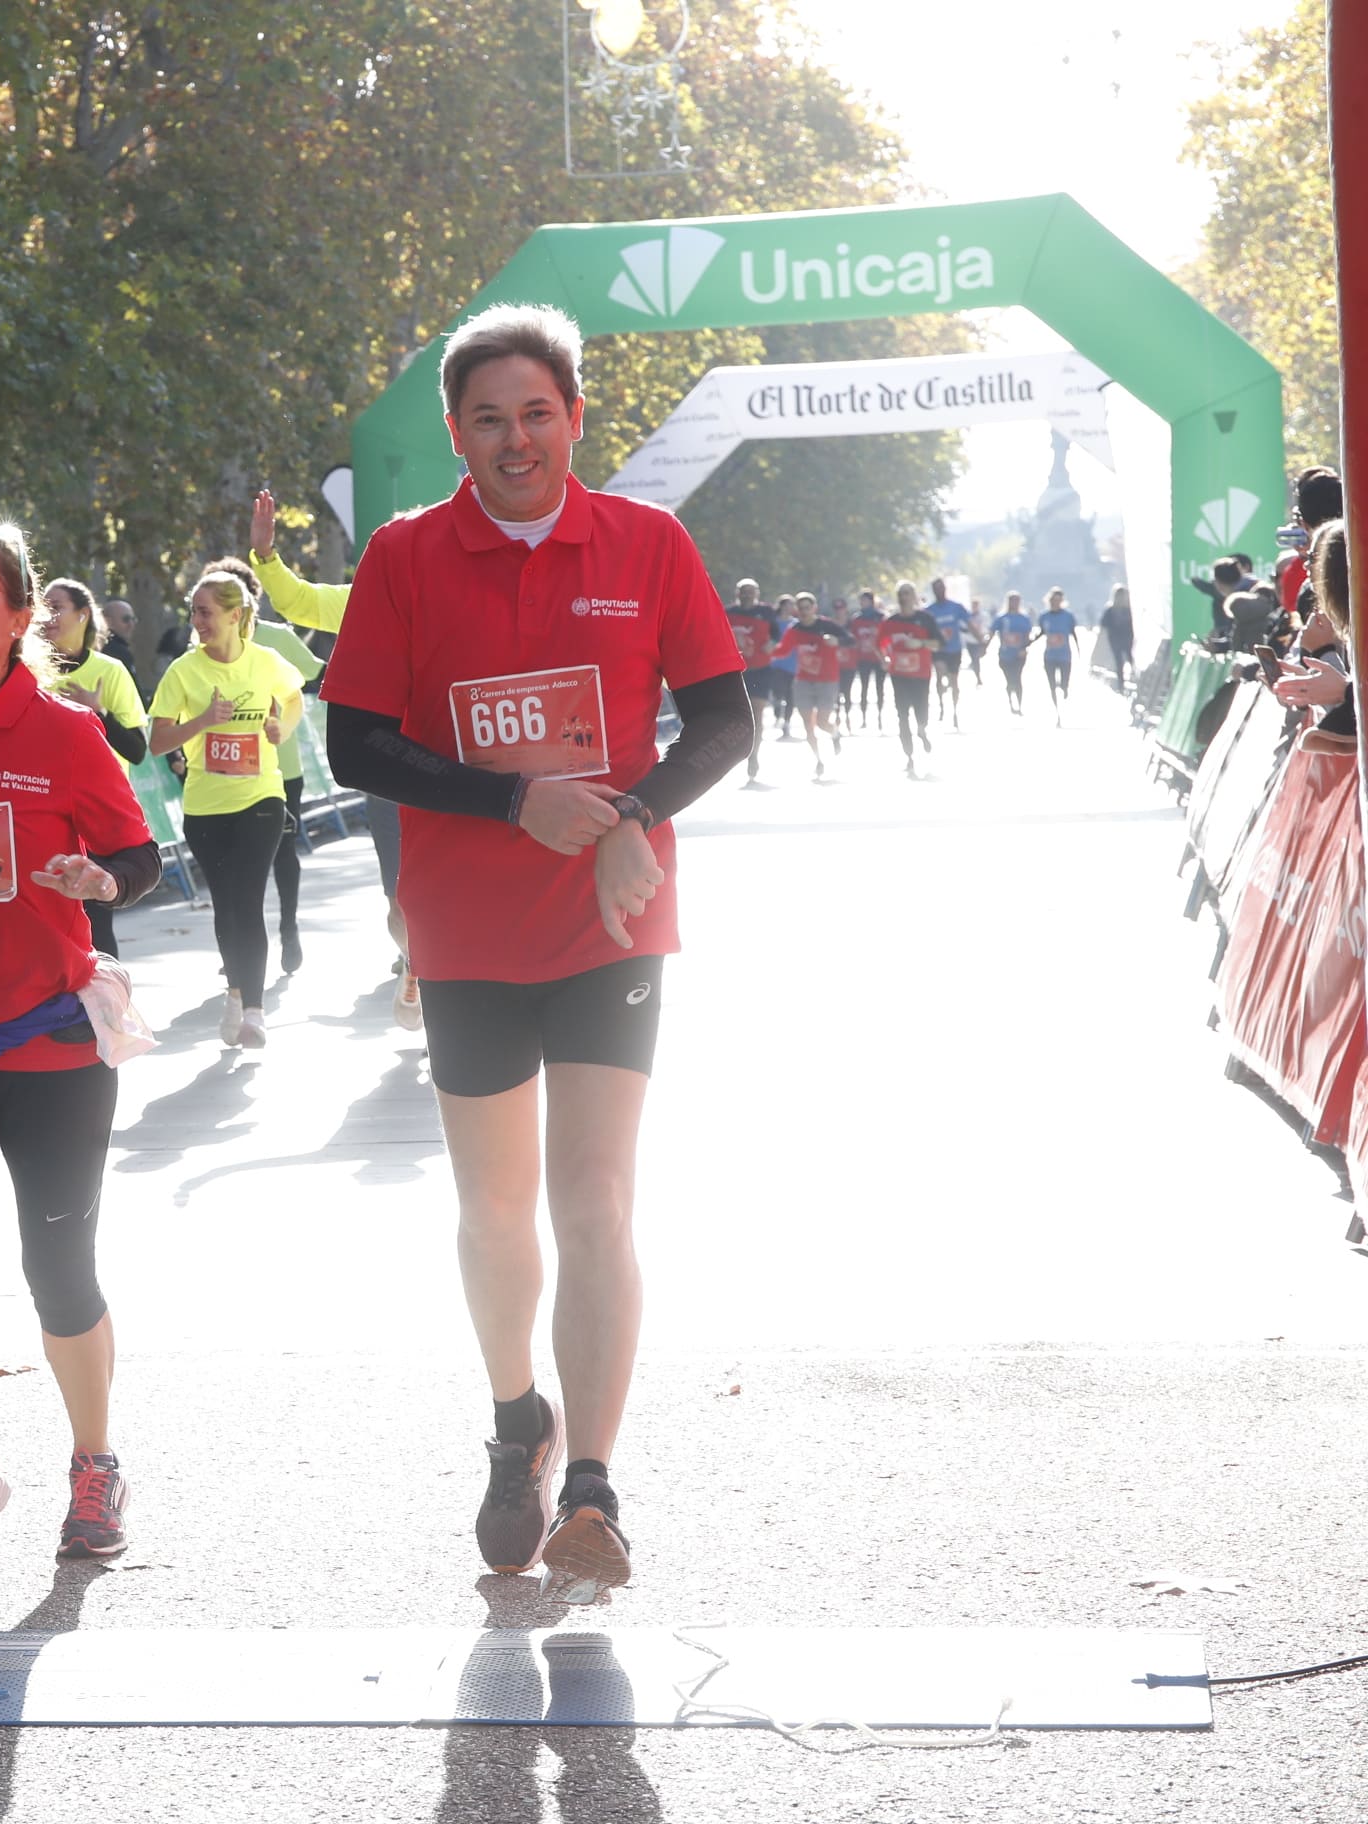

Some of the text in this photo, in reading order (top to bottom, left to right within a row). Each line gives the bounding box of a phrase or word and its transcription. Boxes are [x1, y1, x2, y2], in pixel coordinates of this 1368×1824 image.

[740, 235, 995, 304] Unicaja
[747, 371, 1034, 420] El Norte de Castilla
[480, 690, 507, 698] Carrera
[507, 687, 516, 696] de
[516, 684, 550, 694] empresas
[552, 680, 578, 689] Adecco
[471, 696, 546, 748] 666
[211, 741, 240, 761] 826
[3, 770, 50, 786] DIPUTACIÓN
